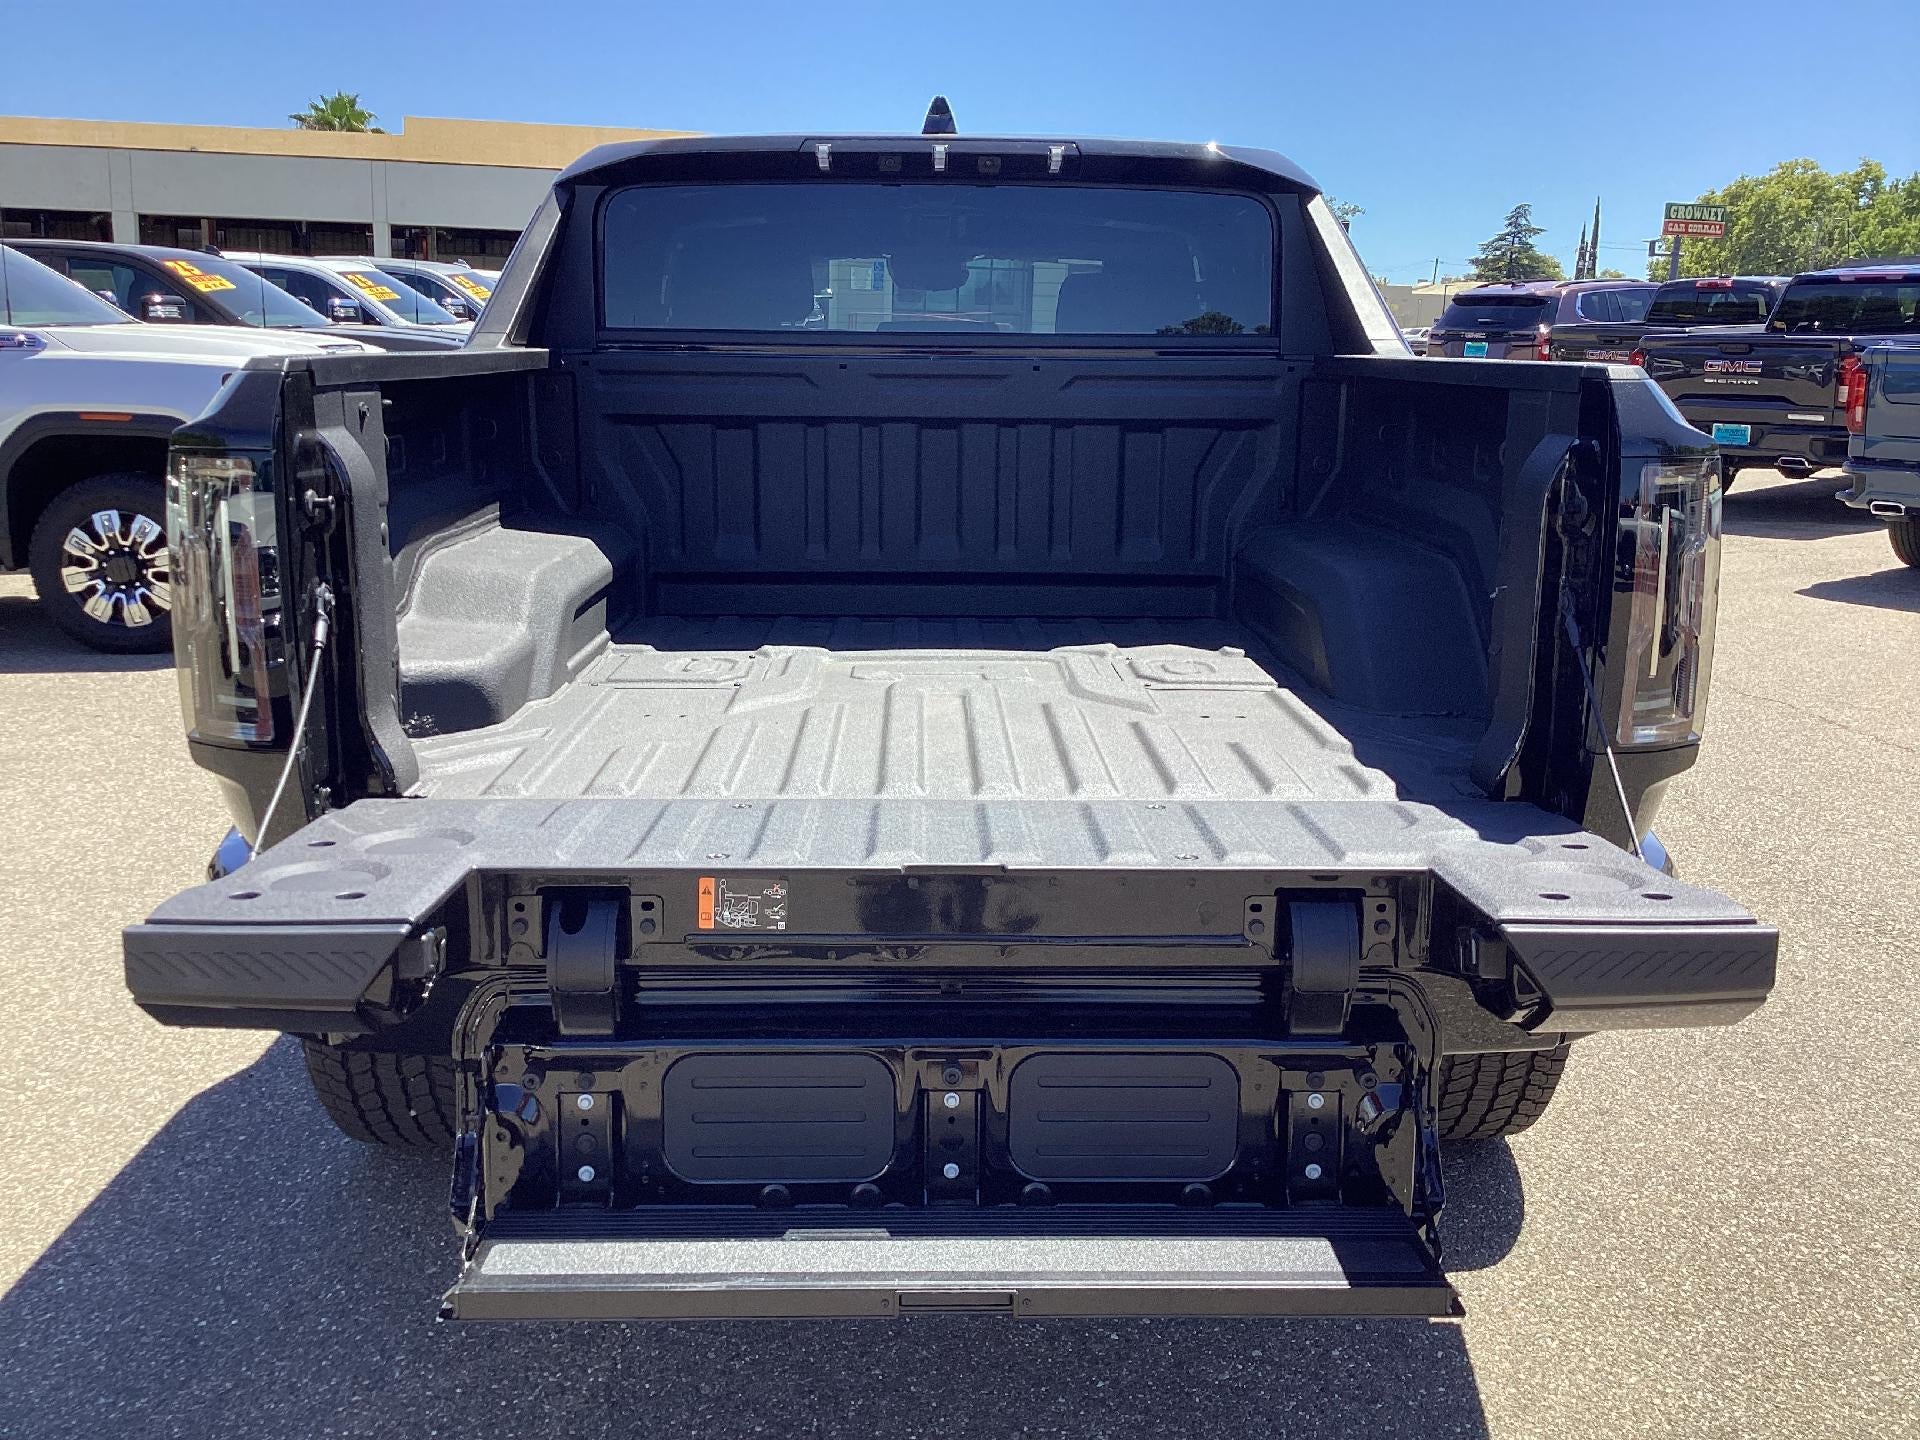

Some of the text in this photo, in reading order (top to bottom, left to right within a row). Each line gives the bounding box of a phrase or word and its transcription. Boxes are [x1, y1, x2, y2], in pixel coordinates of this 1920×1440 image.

[1670, 205, 1724, 221] GROWNEY
[1667, 222, 1722, 234] CAR CORRAL
[1586, 349, 1630, 361] GMC
[1703, 359, 1763, 373] GMC
